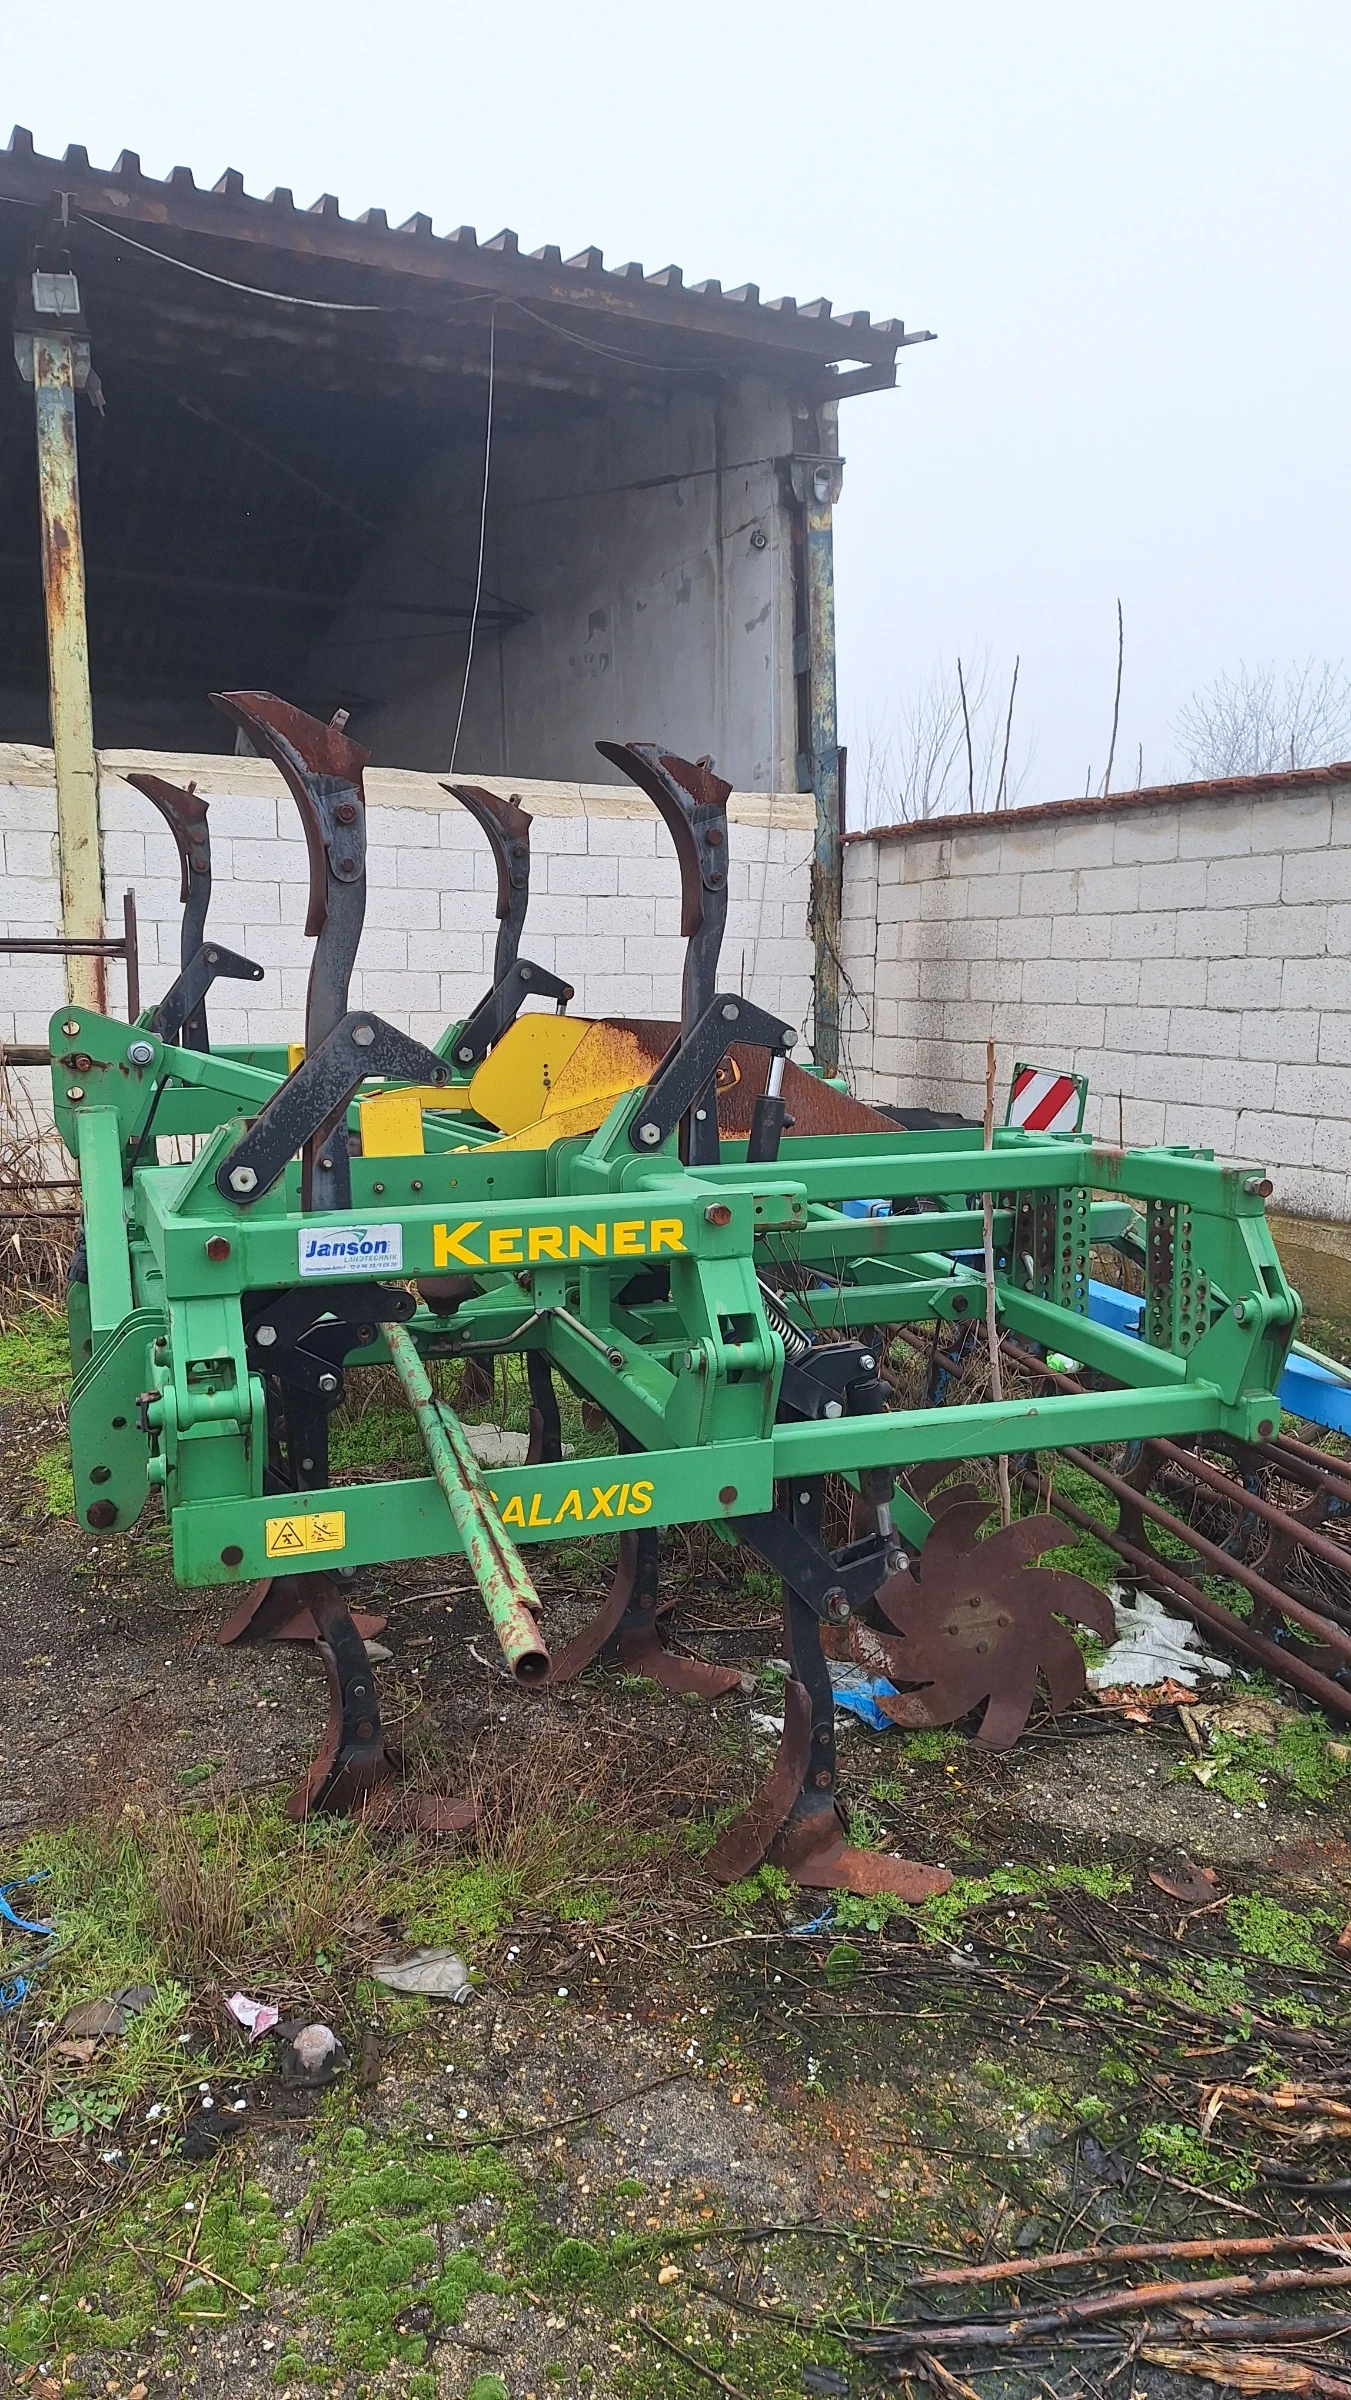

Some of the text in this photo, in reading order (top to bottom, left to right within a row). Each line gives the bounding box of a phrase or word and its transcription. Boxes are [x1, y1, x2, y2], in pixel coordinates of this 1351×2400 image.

[305, 1240, 387, 1258] Janson
[344, 1254, 397, 1263] LANDTECHNIK
[433, 1219, 688, 1267] KERNER
[489, 1480, 654, 1528] ALAXIS
